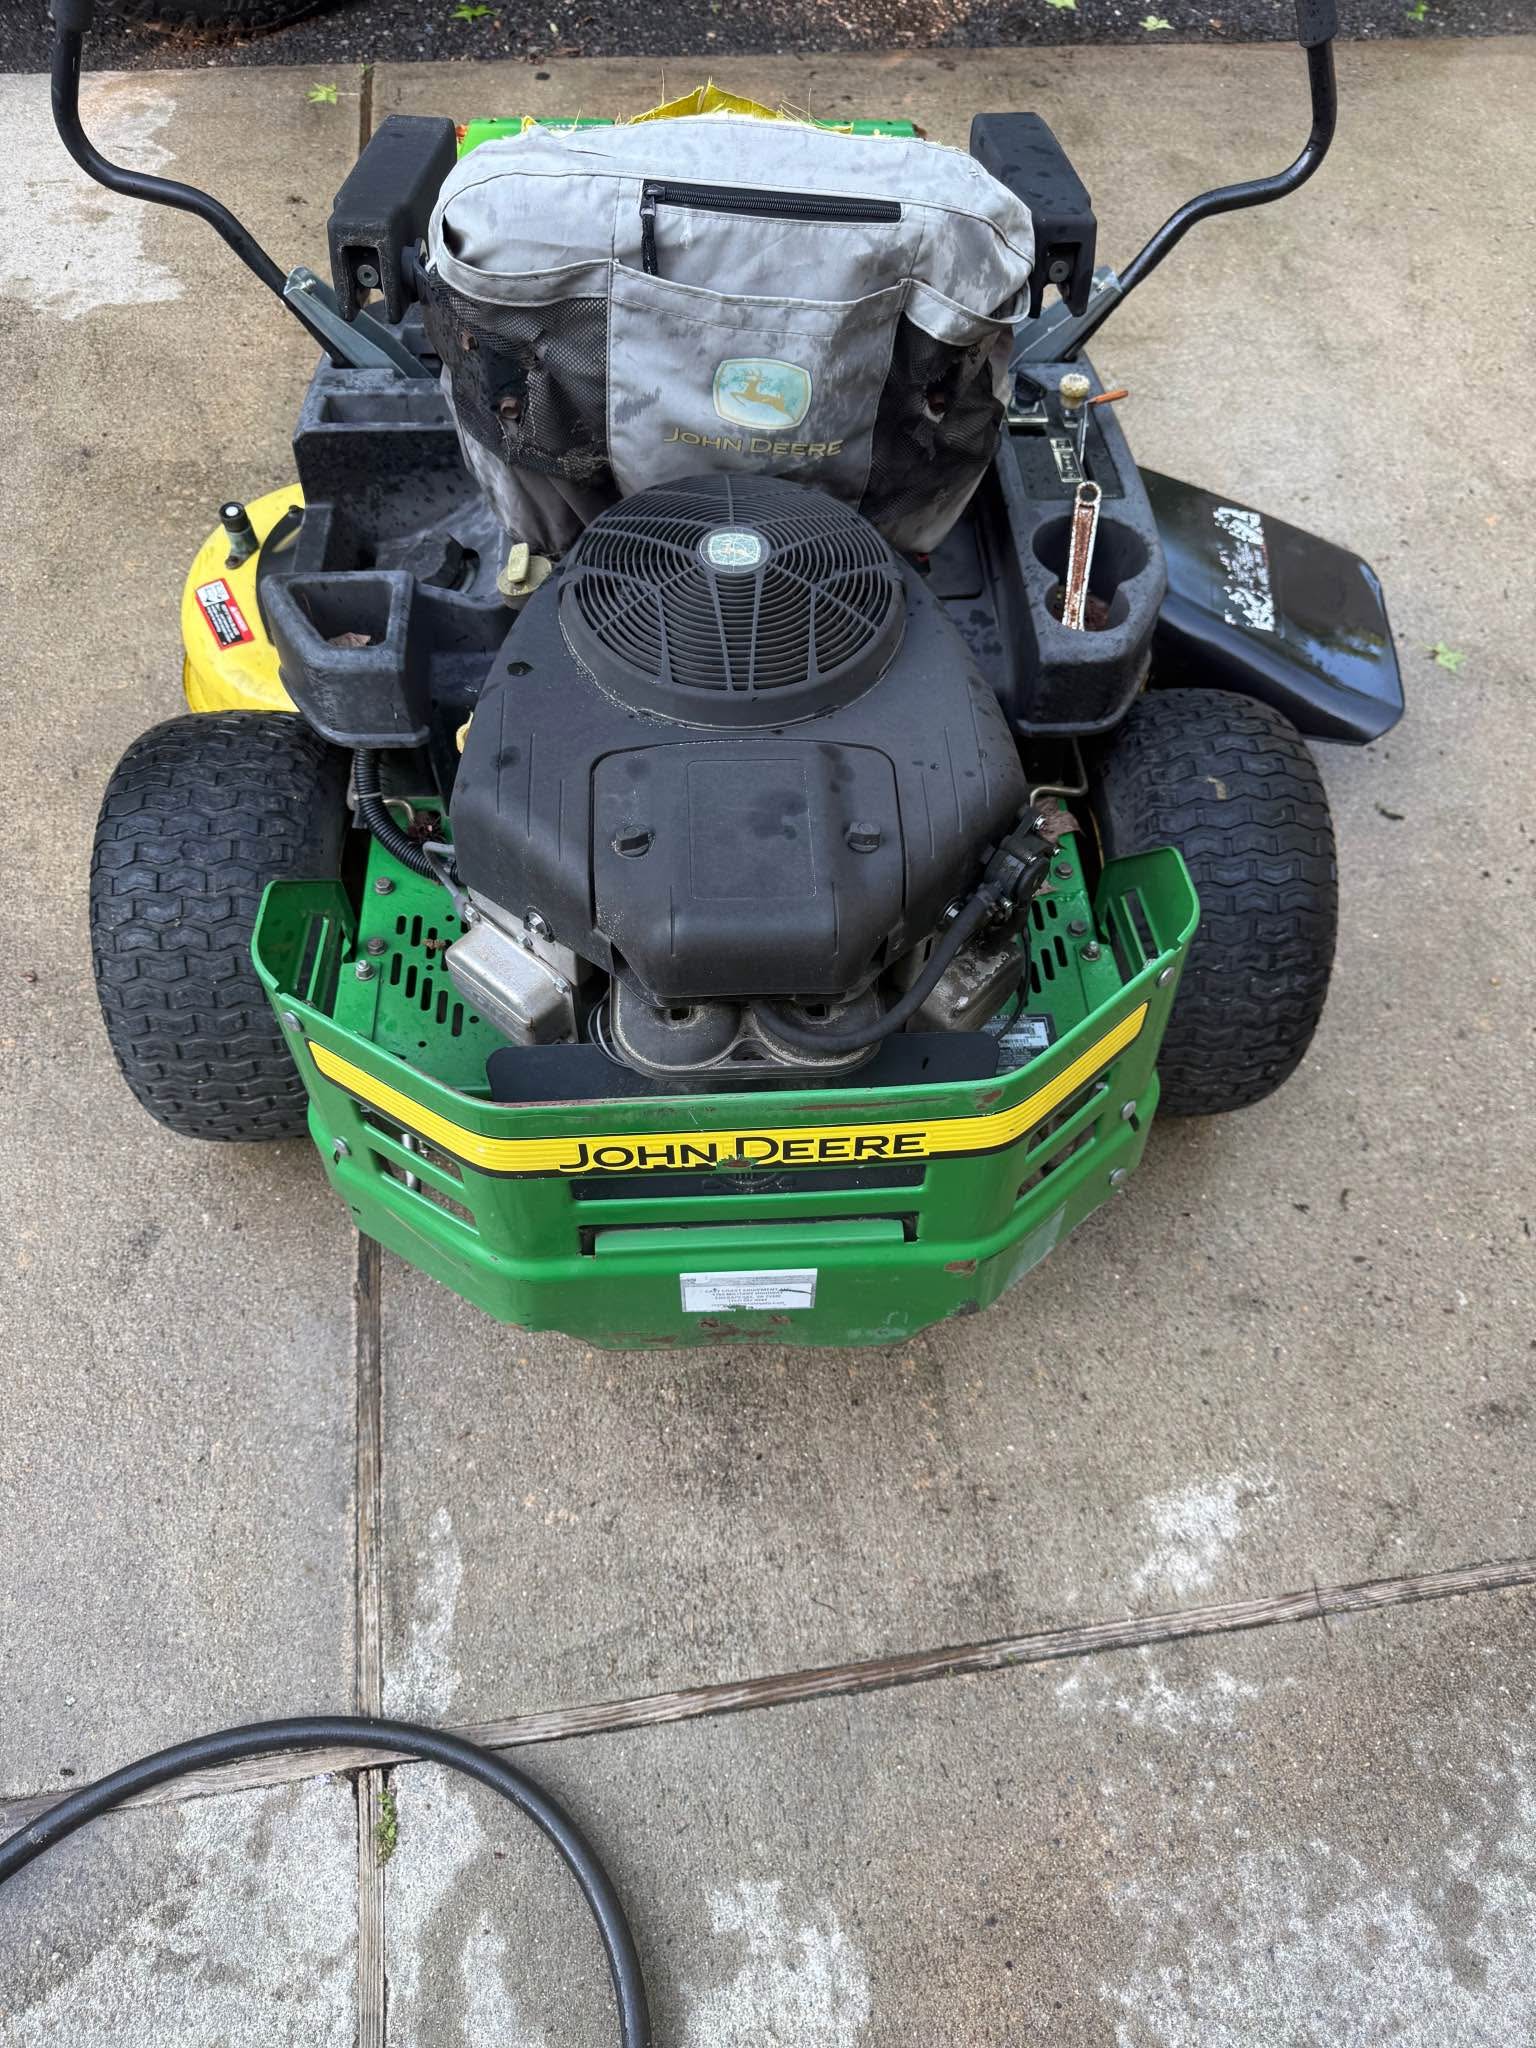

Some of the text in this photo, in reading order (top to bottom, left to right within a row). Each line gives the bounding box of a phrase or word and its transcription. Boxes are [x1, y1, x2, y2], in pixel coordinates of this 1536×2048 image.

[663, 427, 844, 458] JOHN DEERE
[559, 1132, 927, 1170] JOHN DEERE
